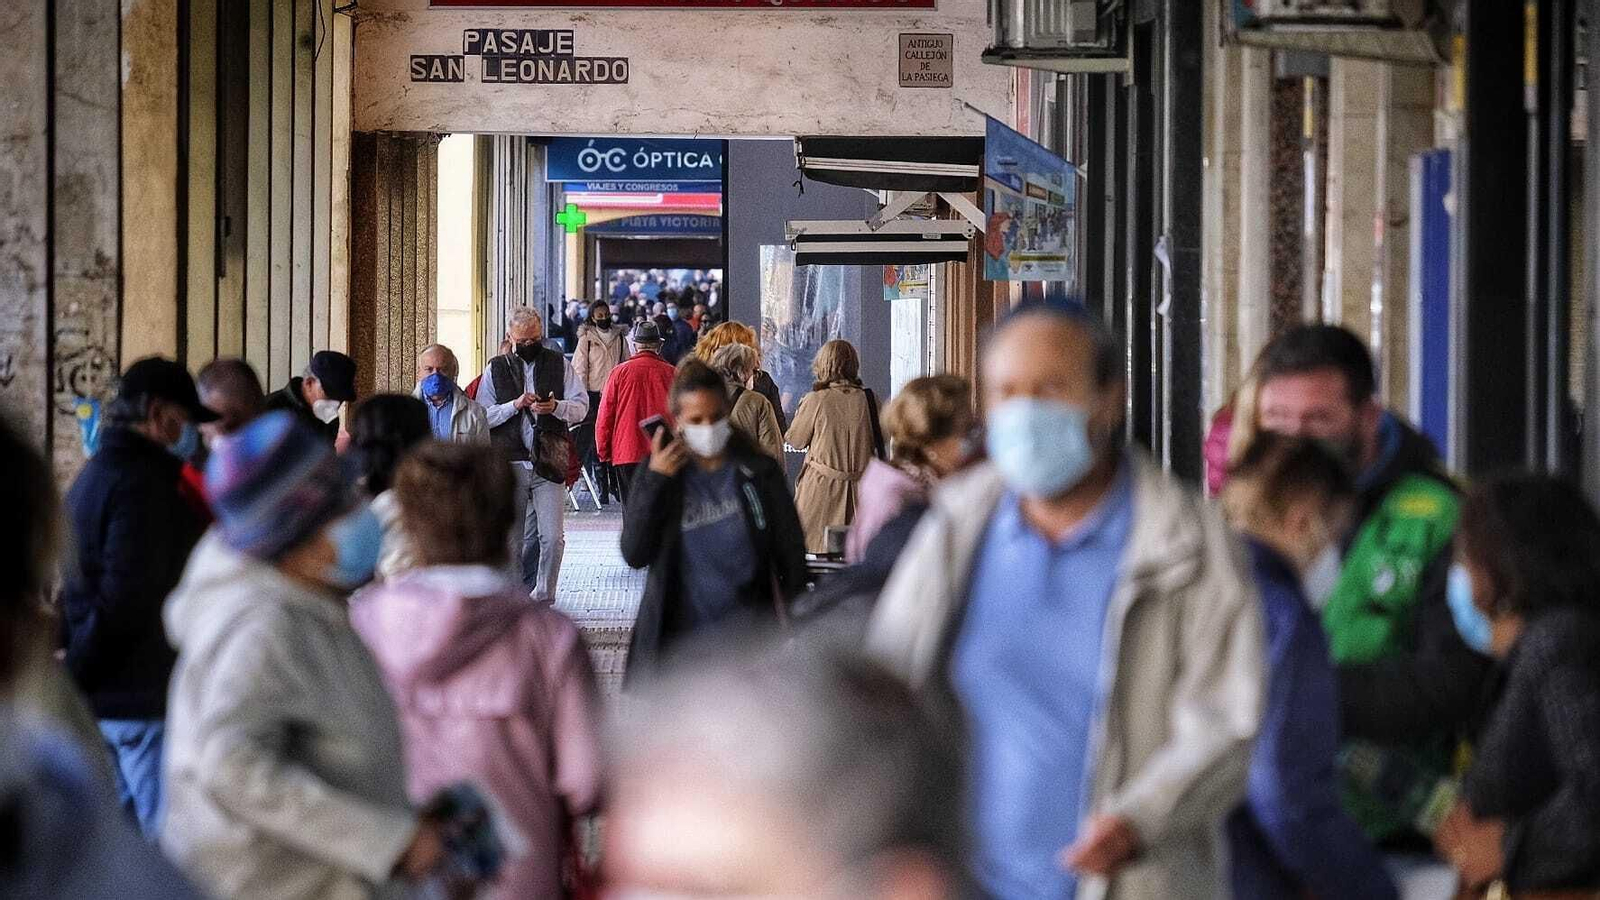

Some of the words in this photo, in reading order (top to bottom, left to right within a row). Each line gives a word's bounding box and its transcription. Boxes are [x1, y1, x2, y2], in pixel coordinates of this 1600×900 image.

[464, 31, 573, 54] PASAJE
[907, 39, 944, 48] ANTIGUO
[905, 49, 947, 60] CALLEJÓN
[411, 58, 464, 80] SAN
[482, 59, 629, 82] LEONARDO
[920, 61, 931, 71] DE
[902, 72, 913, 81] LA
[914, 72, 949, 82] PASIEGA
[633, 147, 713, 169] ÓPTICA
[586, 183, 617, 191] VIAJES
[618, 183, 623, 191] Y
[625, 183, 679, 192] CONGRESOS
[621, 216, 657, 228] PLAYA
[661, 216, 721, 228] VICTORIA
